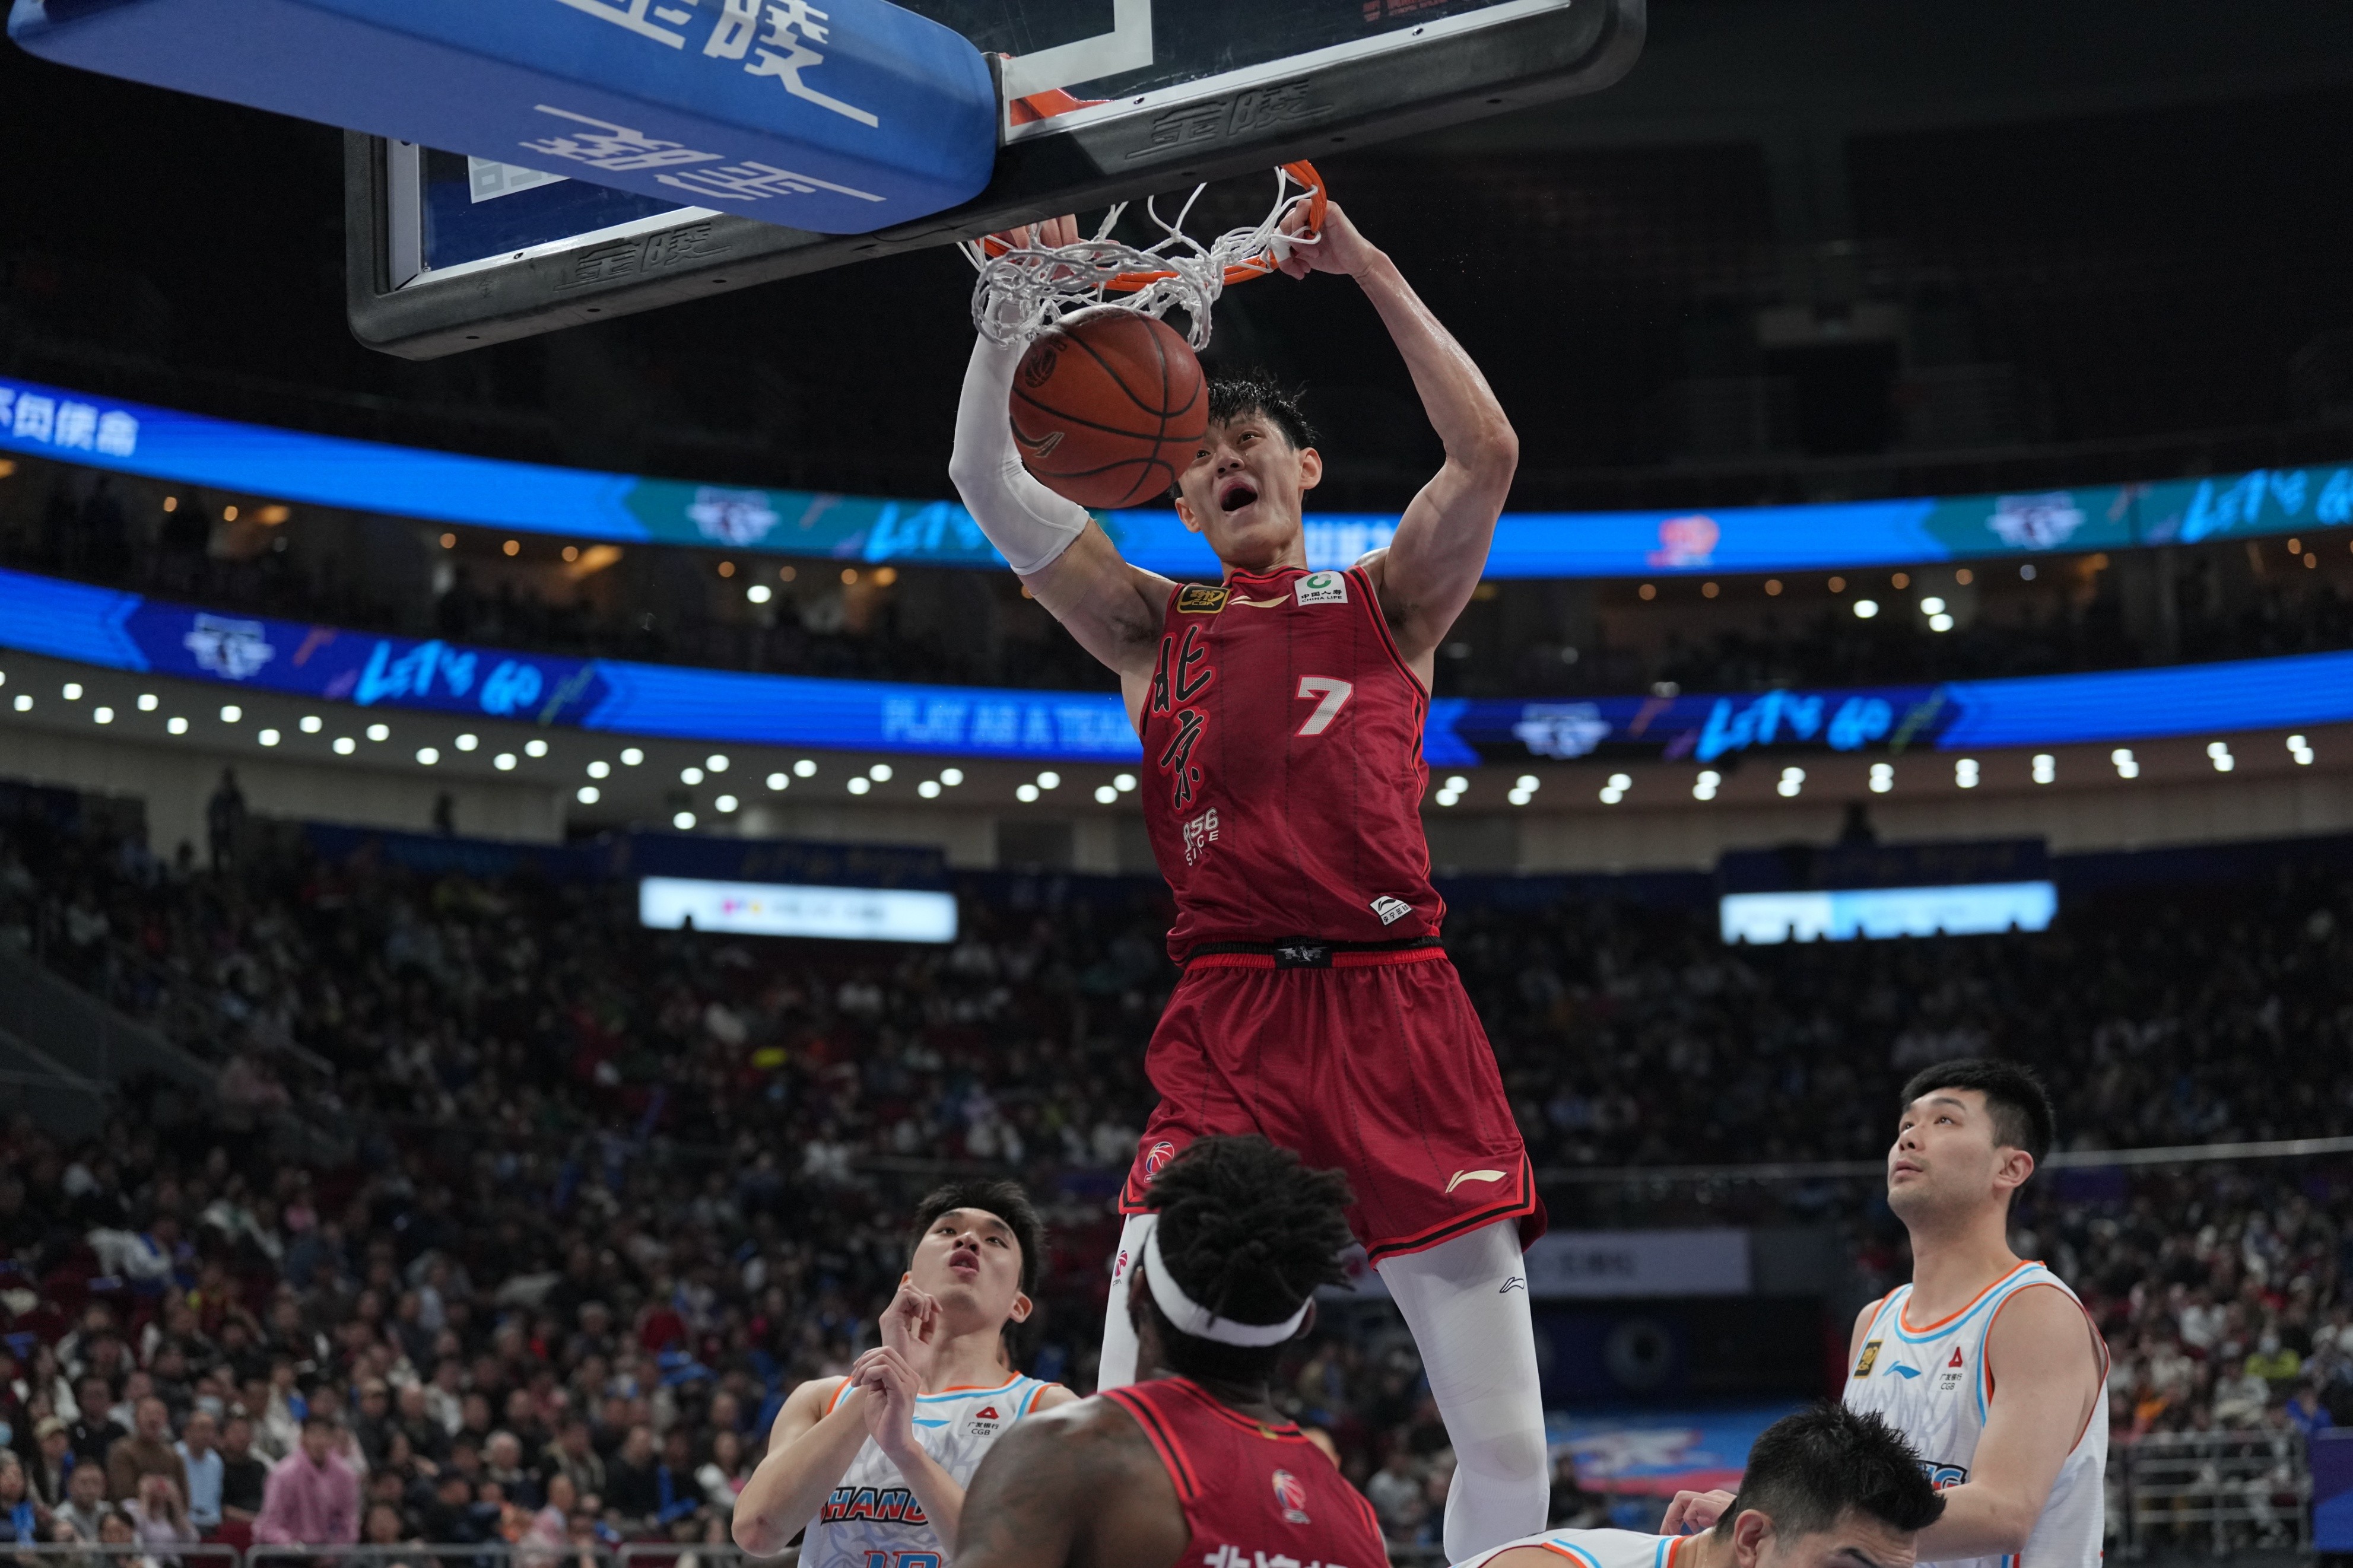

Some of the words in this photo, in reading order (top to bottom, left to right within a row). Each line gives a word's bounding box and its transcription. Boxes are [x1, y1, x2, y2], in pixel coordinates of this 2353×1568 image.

[1125, 79, 1334, 160] 金陵
[552, 221, 731, 292] 金陵
[1301, 589, 1342, 599] 中国人寿
[1153, 625, 1212, 810] 北京
[1295, 675, 1354, 737] 7
[967, 1421, 999, 1430] 广发银行
[820, 1487, 929, 1525] HAND
